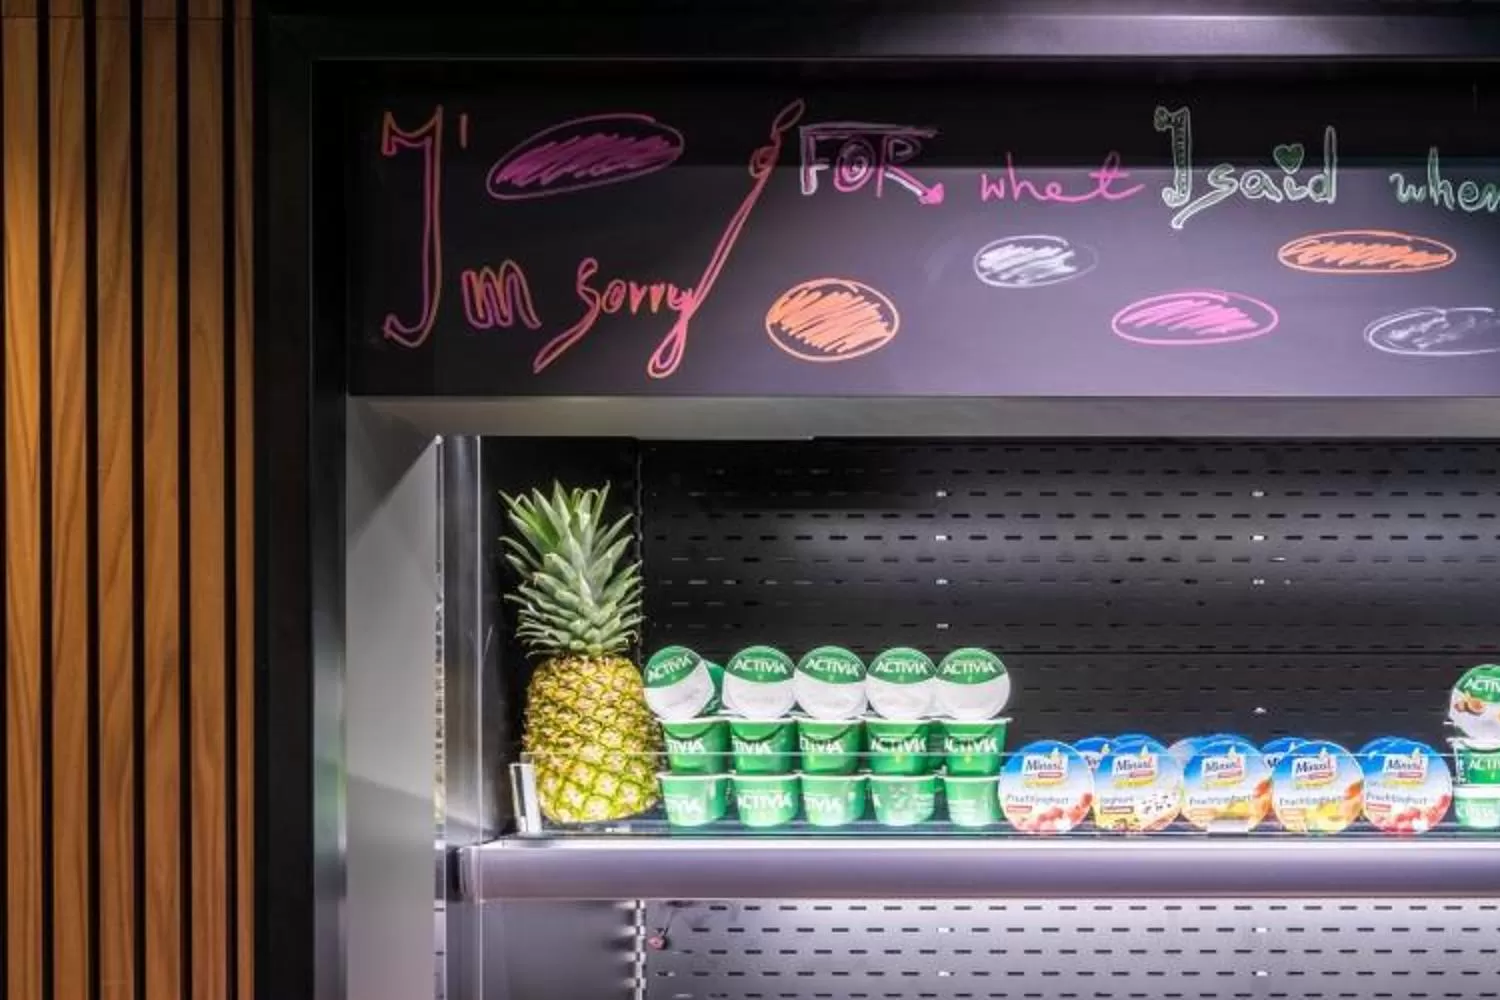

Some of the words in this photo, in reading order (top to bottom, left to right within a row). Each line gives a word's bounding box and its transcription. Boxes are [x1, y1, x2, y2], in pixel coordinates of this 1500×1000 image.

[799, 121, 945, 205] FOR
[647, 655, 692, 683] ACTIVIA
[733, 658, 788, 675] ACTIVIA
[805, 658, 860, 677] ACTIVIA
[875, 659, 929, 675] ACTIVIA
[943, 660, 997, 675] ACTIVIA
